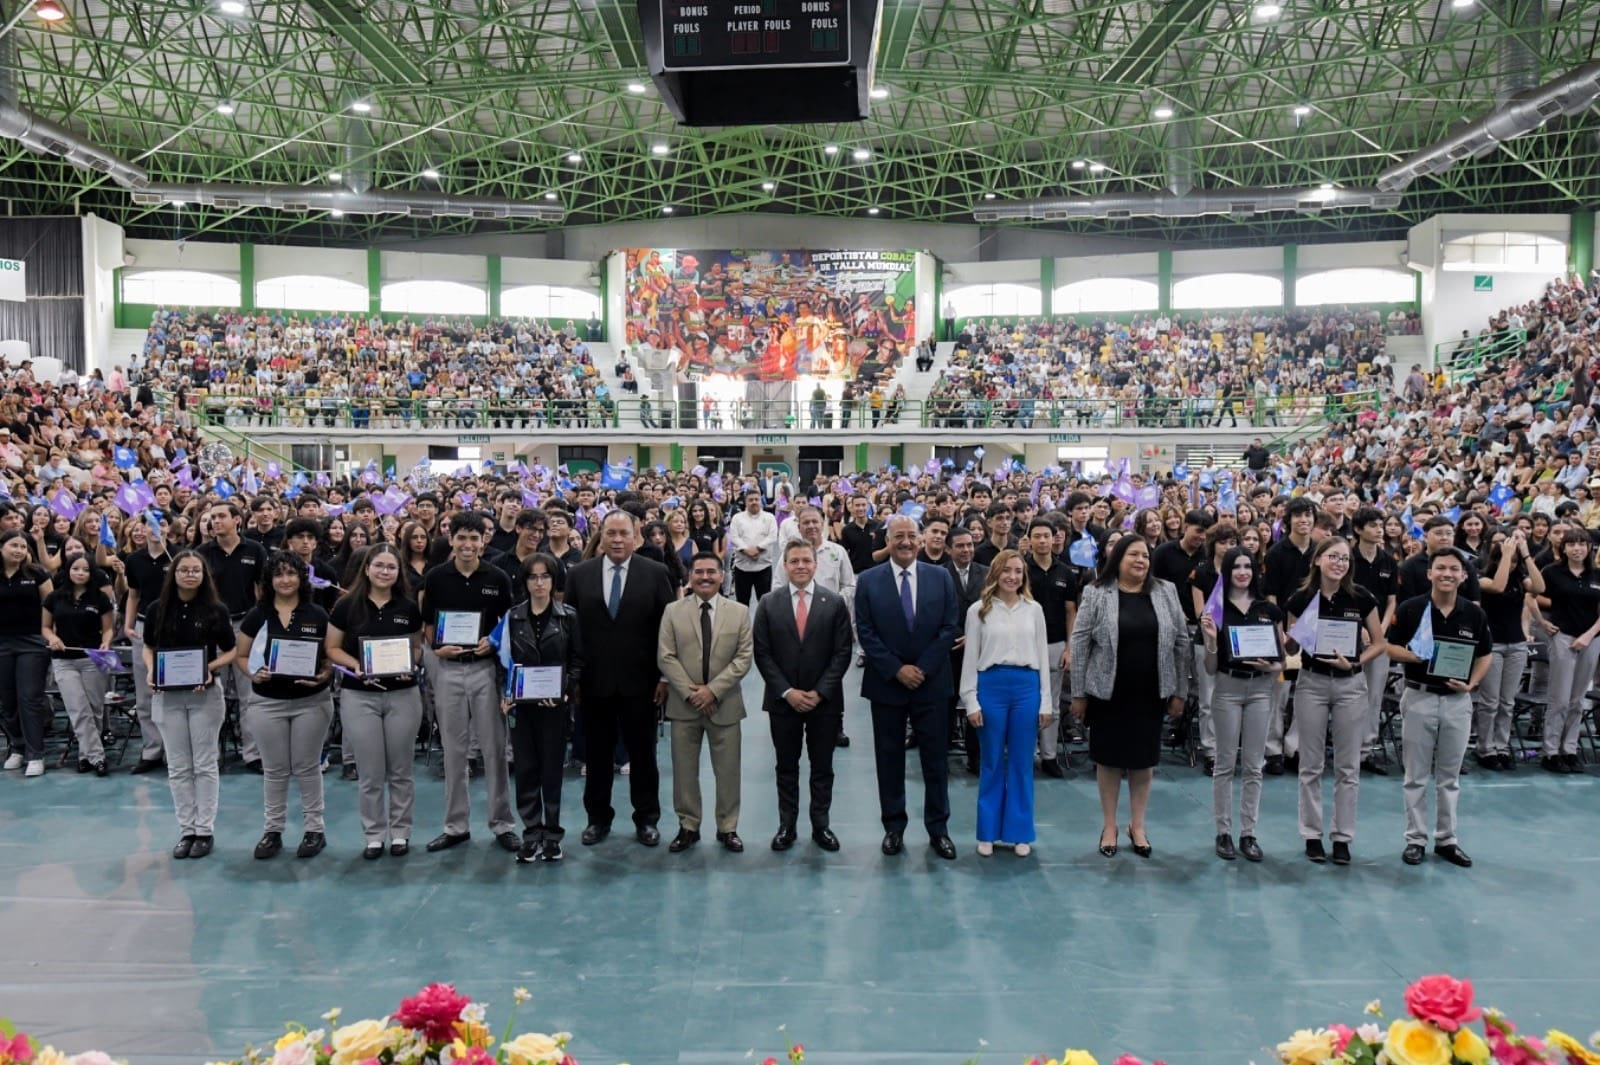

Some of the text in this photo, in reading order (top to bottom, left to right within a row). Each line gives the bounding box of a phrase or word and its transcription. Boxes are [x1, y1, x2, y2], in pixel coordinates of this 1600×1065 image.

[680, 6, 708, 17] BONUS
[734, 5, 761, 15] PERIOD
[801, 1, 830, 12] BONUS
[673, 23, 700, 34] FOULS
[727, 19, 791, 32] PLAYER FOULS
[811, 18, 838, 29] FOULS
[811, 252, 878, 261] DEPORTISTAS
[820, 261, 911, 271] DE TALLA MUNDIAL
[1050, 434, 1080, 443] SALIDA
